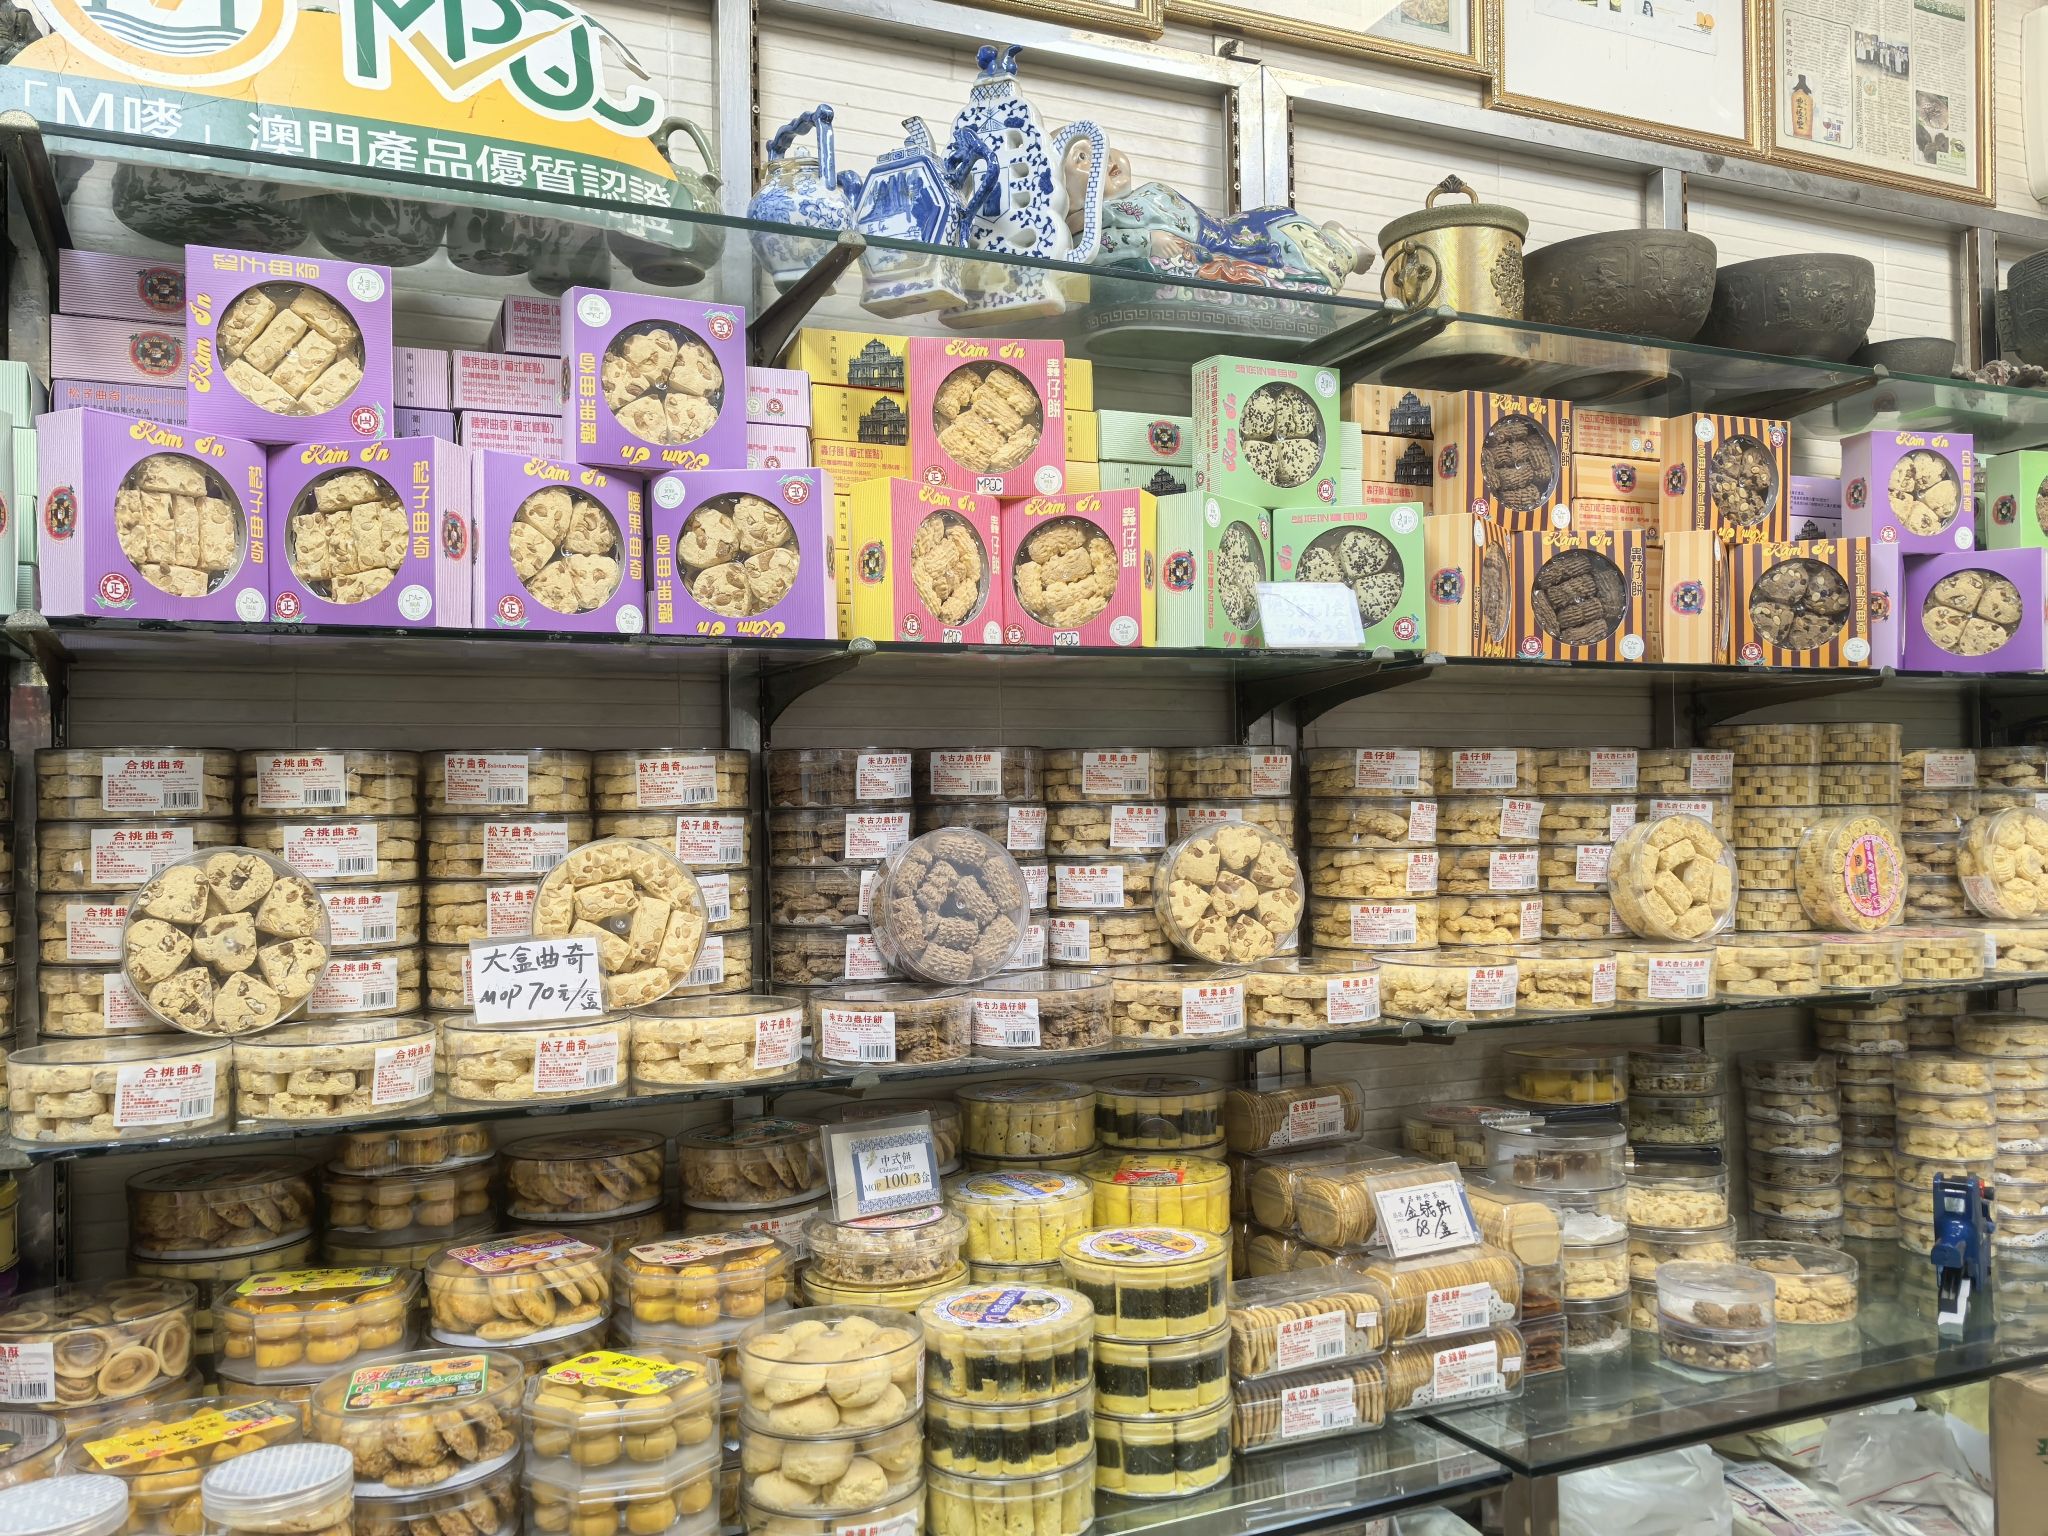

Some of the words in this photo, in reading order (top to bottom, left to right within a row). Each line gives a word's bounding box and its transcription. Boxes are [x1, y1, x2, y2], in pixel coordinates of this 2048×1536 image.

[579, 352, 598, 445] 腰果曲奇
[248, 465, 265, 564] 松子曲奇
[412, 461, 430, 560] 松子曲奇
[125, 759, 185, 770] 合桃曲奇
[272, 758, 324, 768] 合桃曲奇
[447, 758, 487, 769] 松子曲奇
[639, 761, 681, 773] 松子曲奇
[681, 819, 720, 830] 松子曲奇
[113, 830, 174, 841] 合桃曲奇
[303, 827, 360, 837] 合桃曲奇
[487, 825, 533, 838] 松子曲奇
[329, 895, 383, 907] 合桃曲奇
[481, 940, 595, 975] 大盒曲奇
[329, 961, 384, 973] 合桃曲奇
[760, 1017, 792, 1032] 松子曲奇
[541, 1039, 587, 1053] 松子曲奇
[395, 1045, 431, 1060] 合桃曲奇
[143, 1063, 202, 1078] 合桃曲奇
